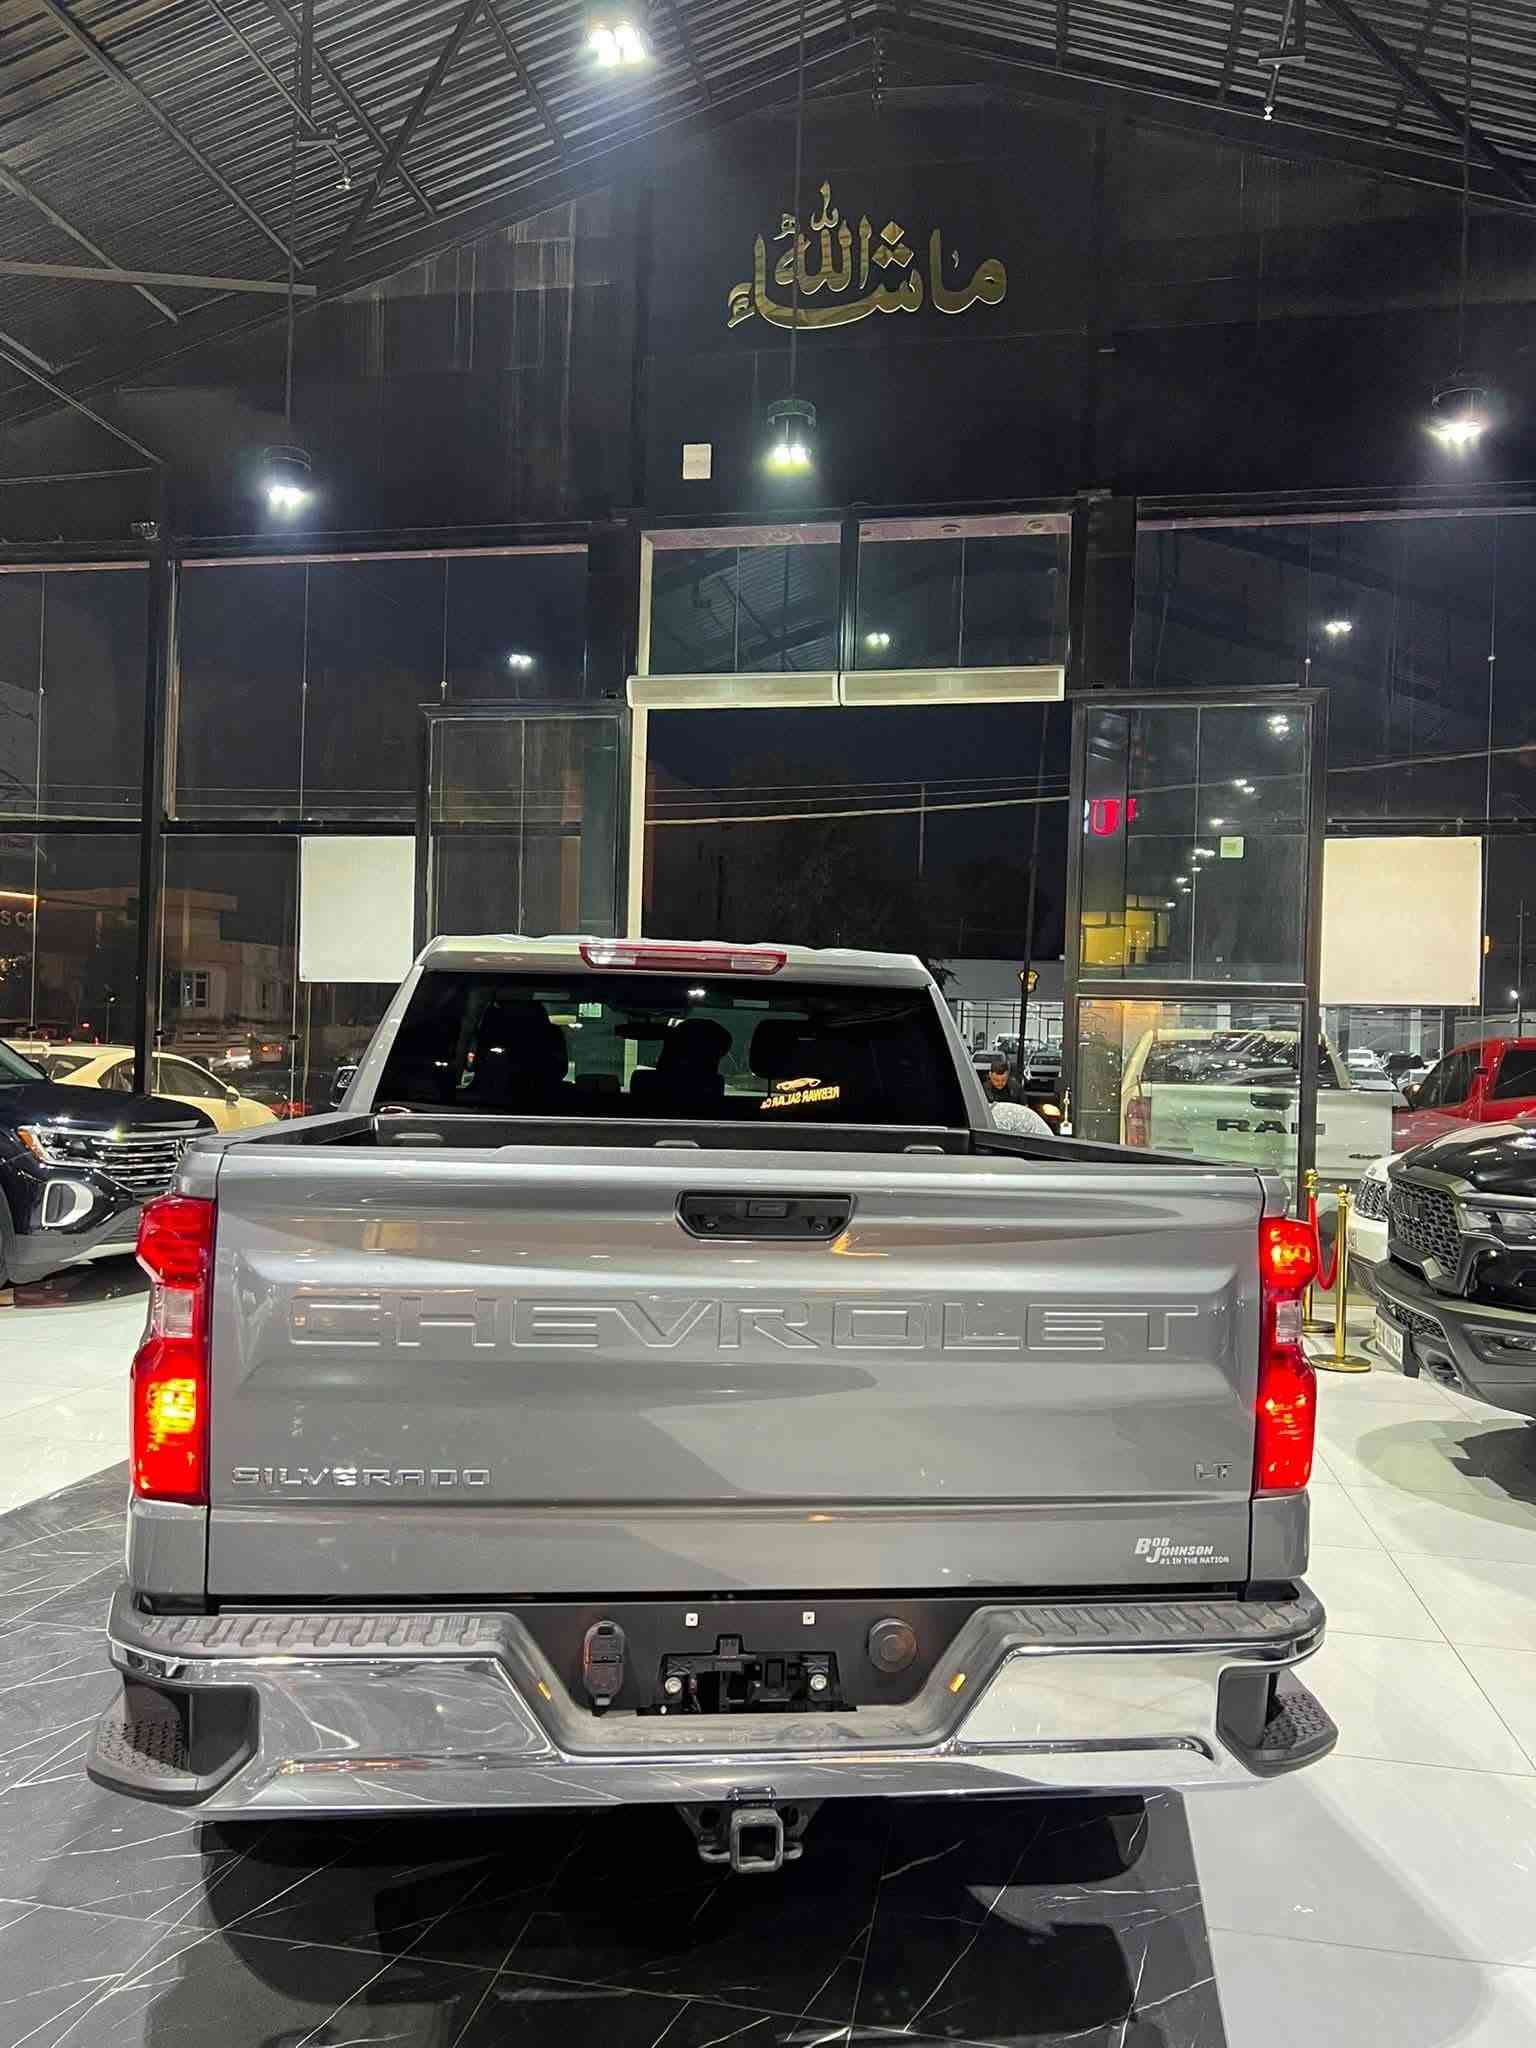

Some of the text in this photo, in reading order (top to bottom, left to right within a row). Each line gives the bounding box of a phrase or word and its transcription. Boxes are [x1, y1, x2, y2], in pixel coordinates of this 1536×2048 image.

[288, 1293, 1200, 1352] CHEVROLET
[231, 1466, 492, 1488] SILVERADO
[1194, 1462, 1233, 1480] LT
[1184, 1556, 1198, 1564] THE
[1199, 1556, 1230, 1564] NATION
